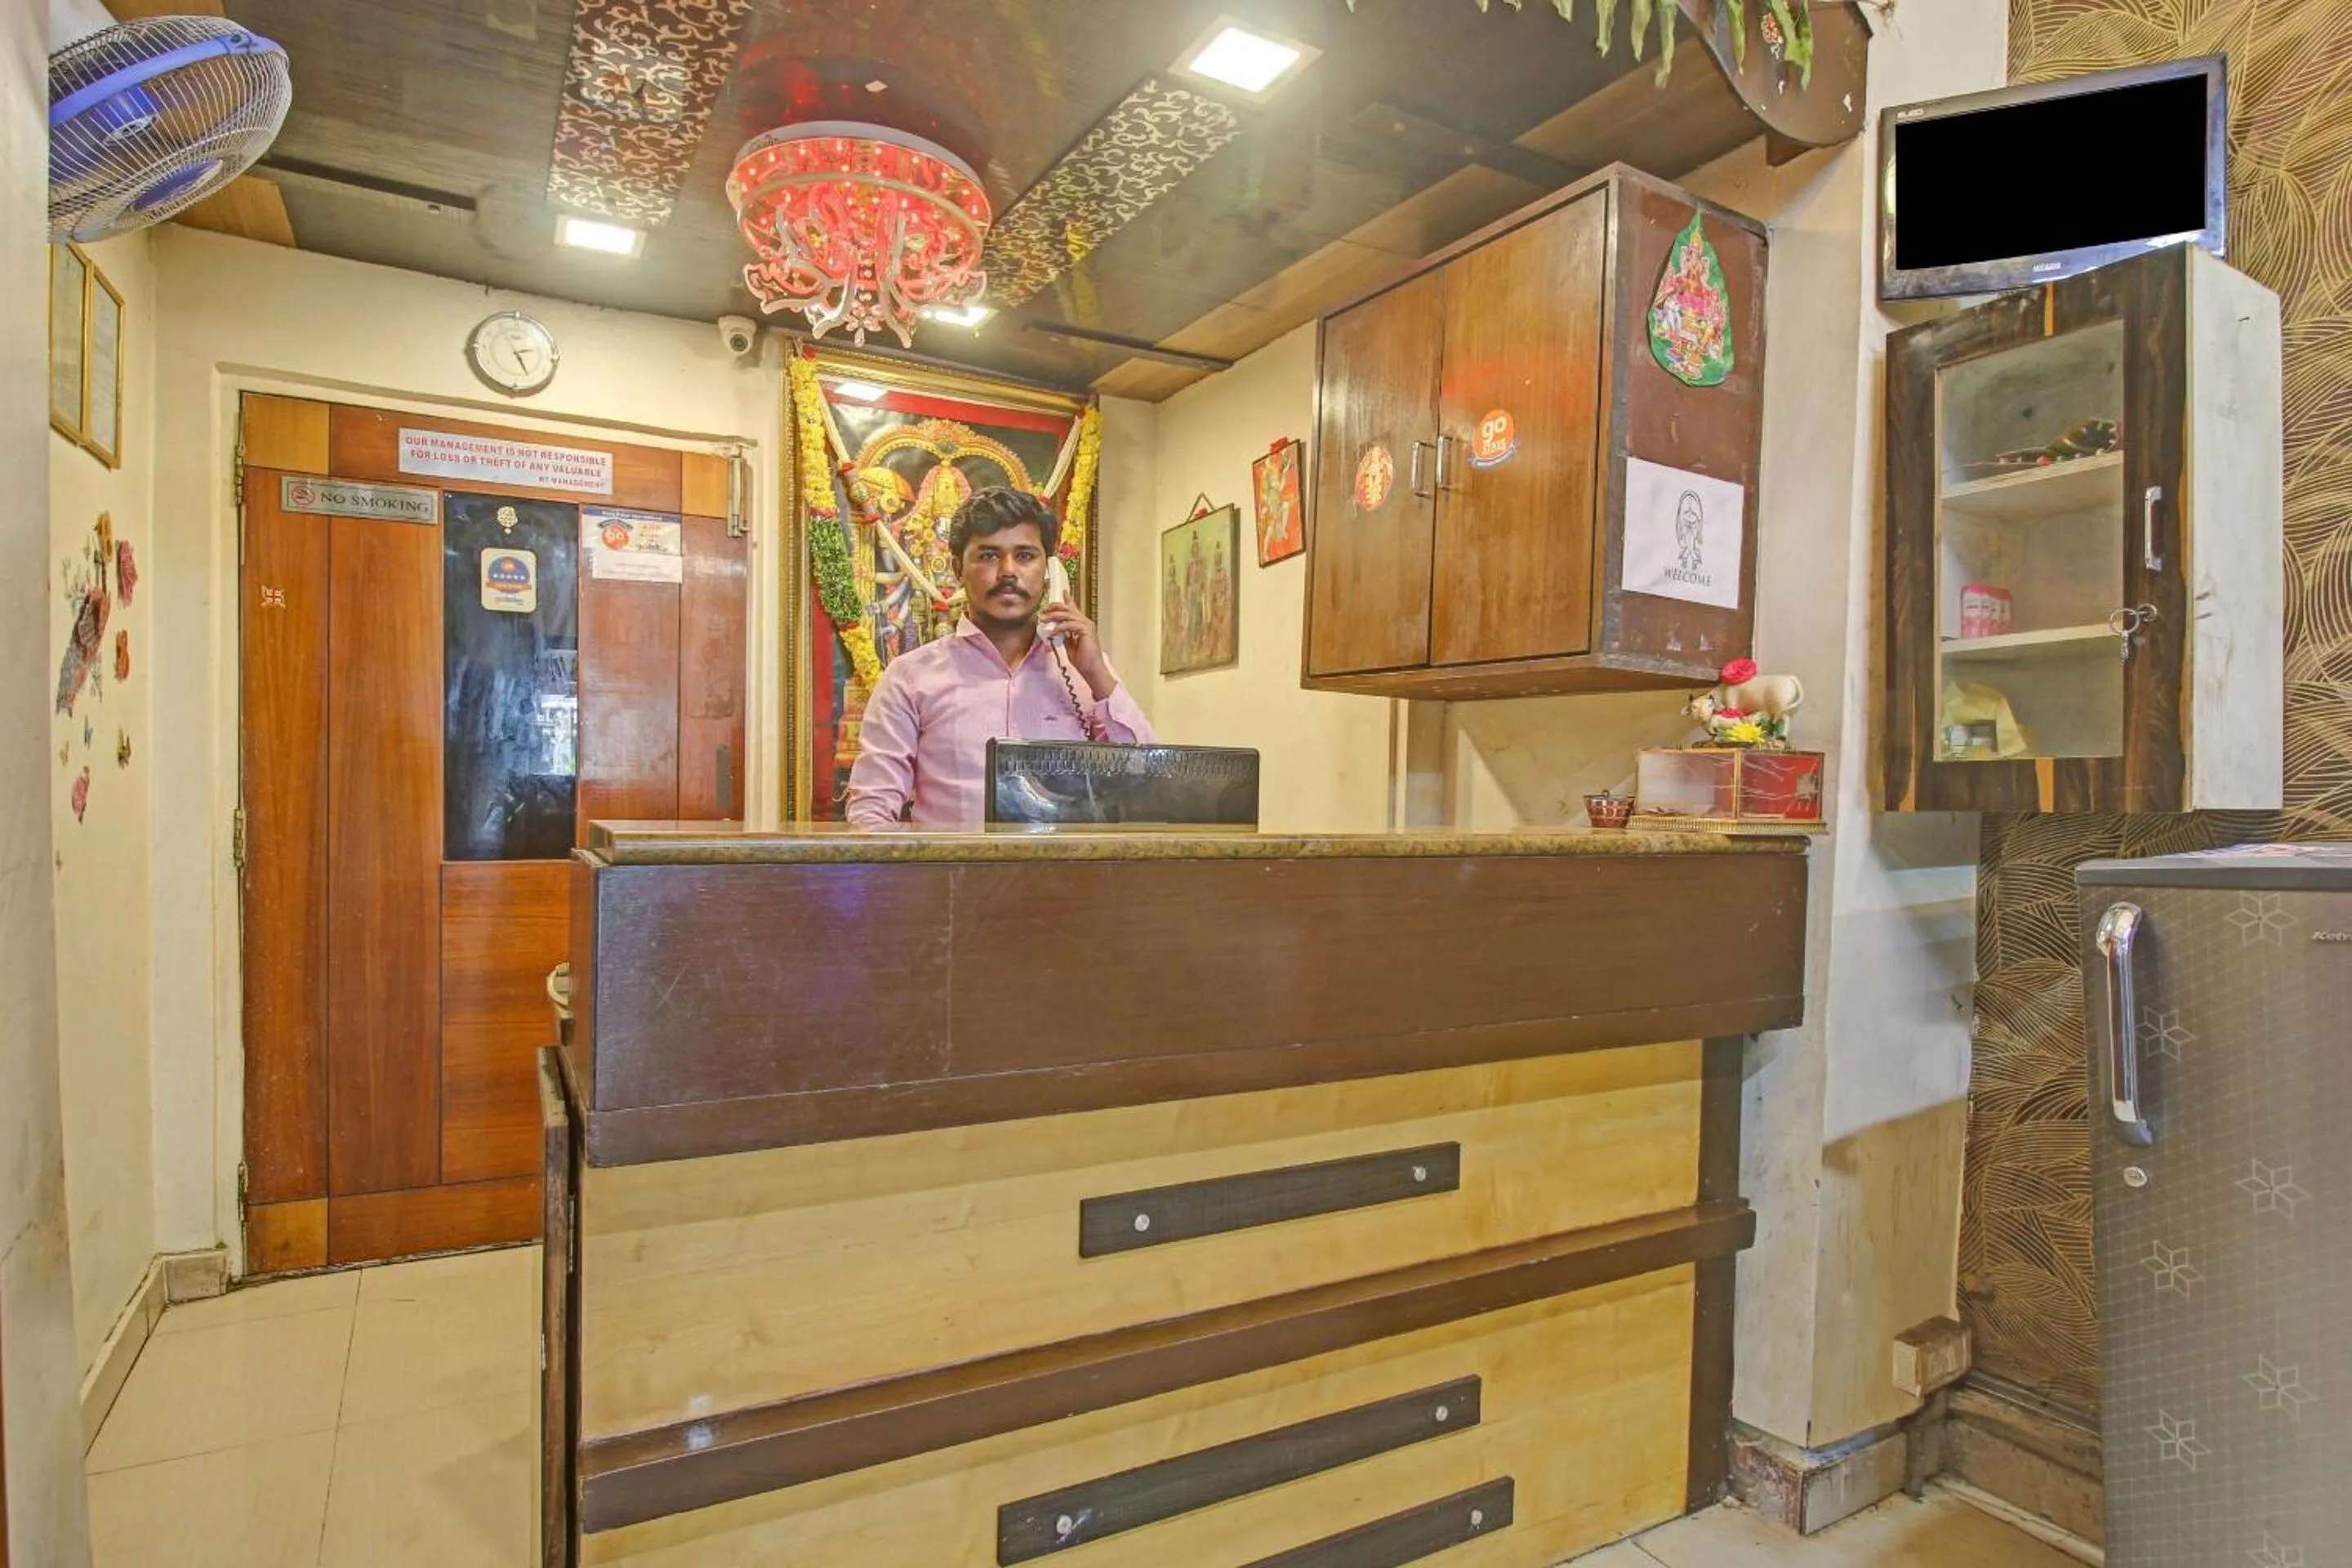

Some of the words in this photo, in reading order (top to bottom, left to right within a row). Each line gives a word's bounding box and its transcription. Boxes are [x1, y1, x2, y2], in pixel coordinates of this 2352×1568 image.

[406, 436, 428, 446] OUR
[431, 439, 503, 454] MANAGEMENT
[506, 447, 515, 456] IS
[518, 448, 537, 458] NOT
[541, 451, 608, 466] RESPONSIBLE
[411, 449, 430, 460] FOR
[434, 452, 460, 464] LOSS
[463, 455, 478, 465] OR
[480, 457, 511, 469] THEFT
[514, 460, 528, 470] OF
[529, 461, 550, 472] ANY
[552, 464, 601, 478] VALUABLE
[320, 492, 345, 504] NO
[351, 494, 429, 513] SMOKING
[1664, 566, 1713, 587] WELCOME
